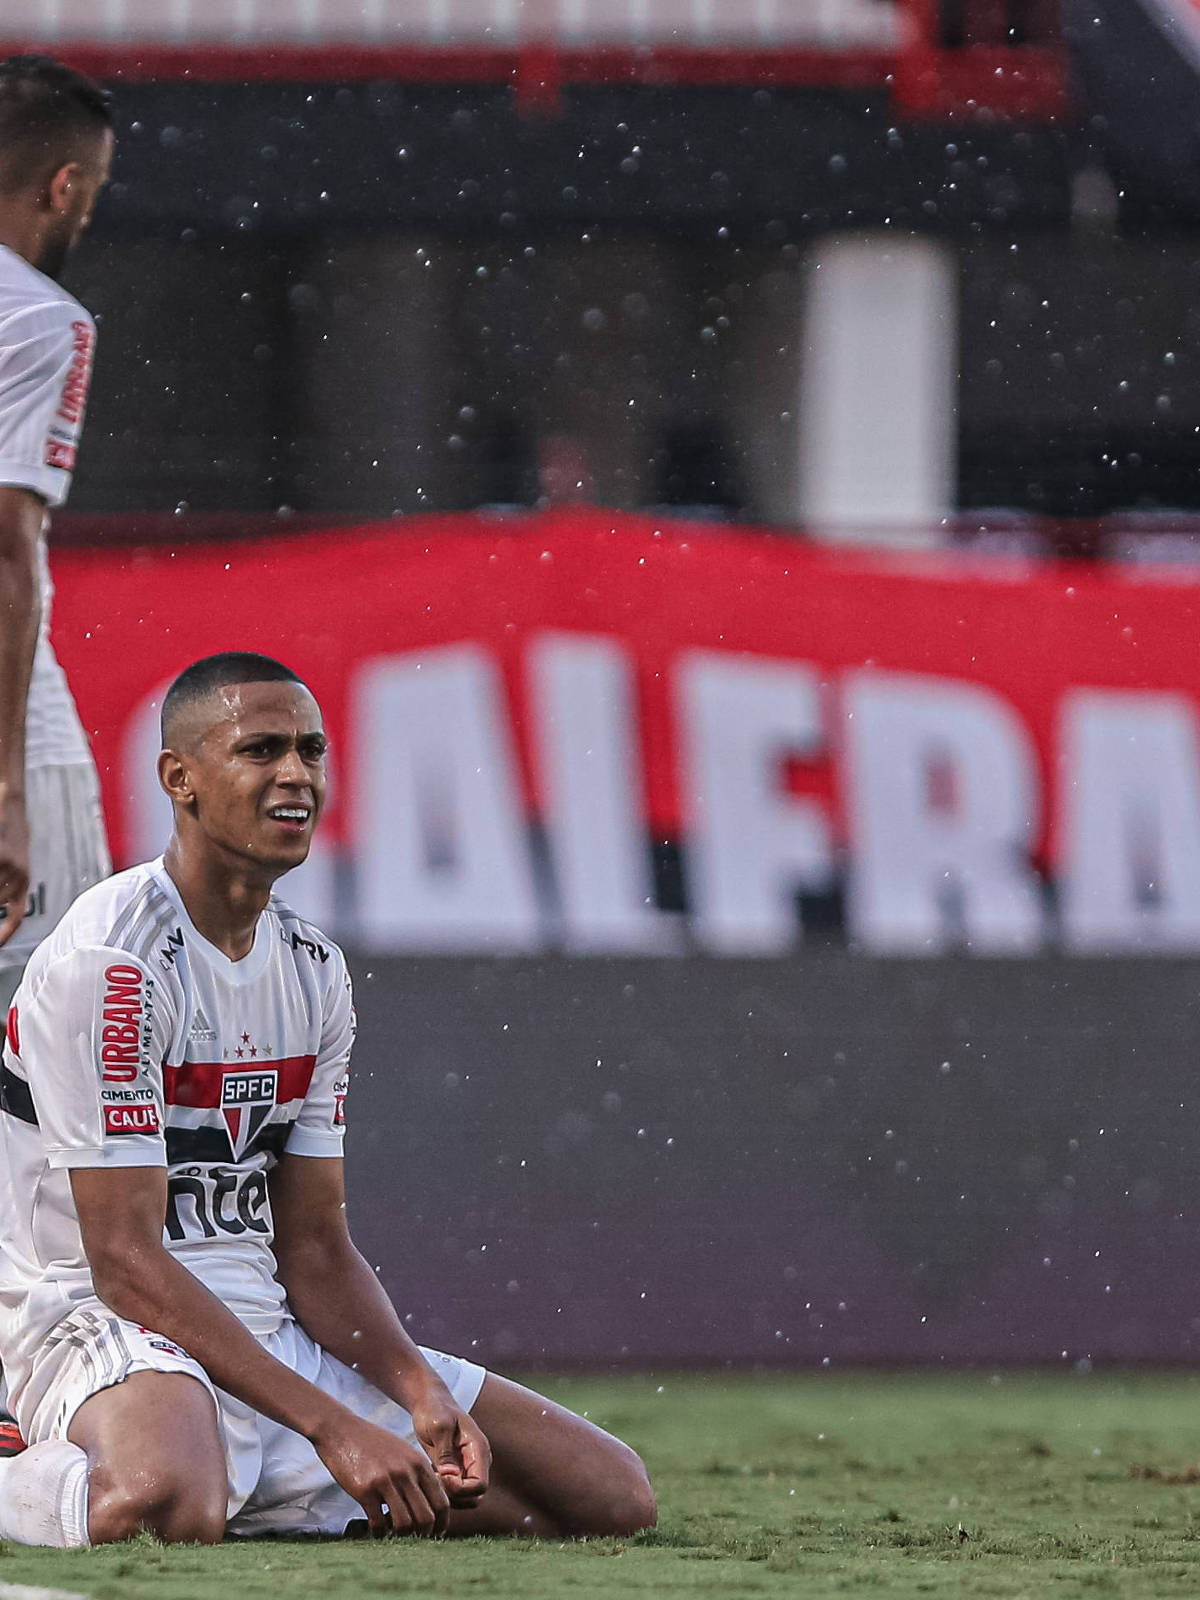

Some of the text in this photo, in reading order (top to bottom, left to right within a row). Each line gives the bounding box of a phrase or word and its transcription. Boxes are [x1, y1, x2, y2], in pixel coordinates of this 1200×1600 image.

[120, 628, 1200, 958] ALFRA
[102, 964, 143, 1082] URBANO
[141, 978, 155, 1077] ALIMENTOS
[101, 1089, 154, 1101] CIMENTO
[224, 1078, 273, 1099] SPFC
[164, 1167, 271, 1241] nte
